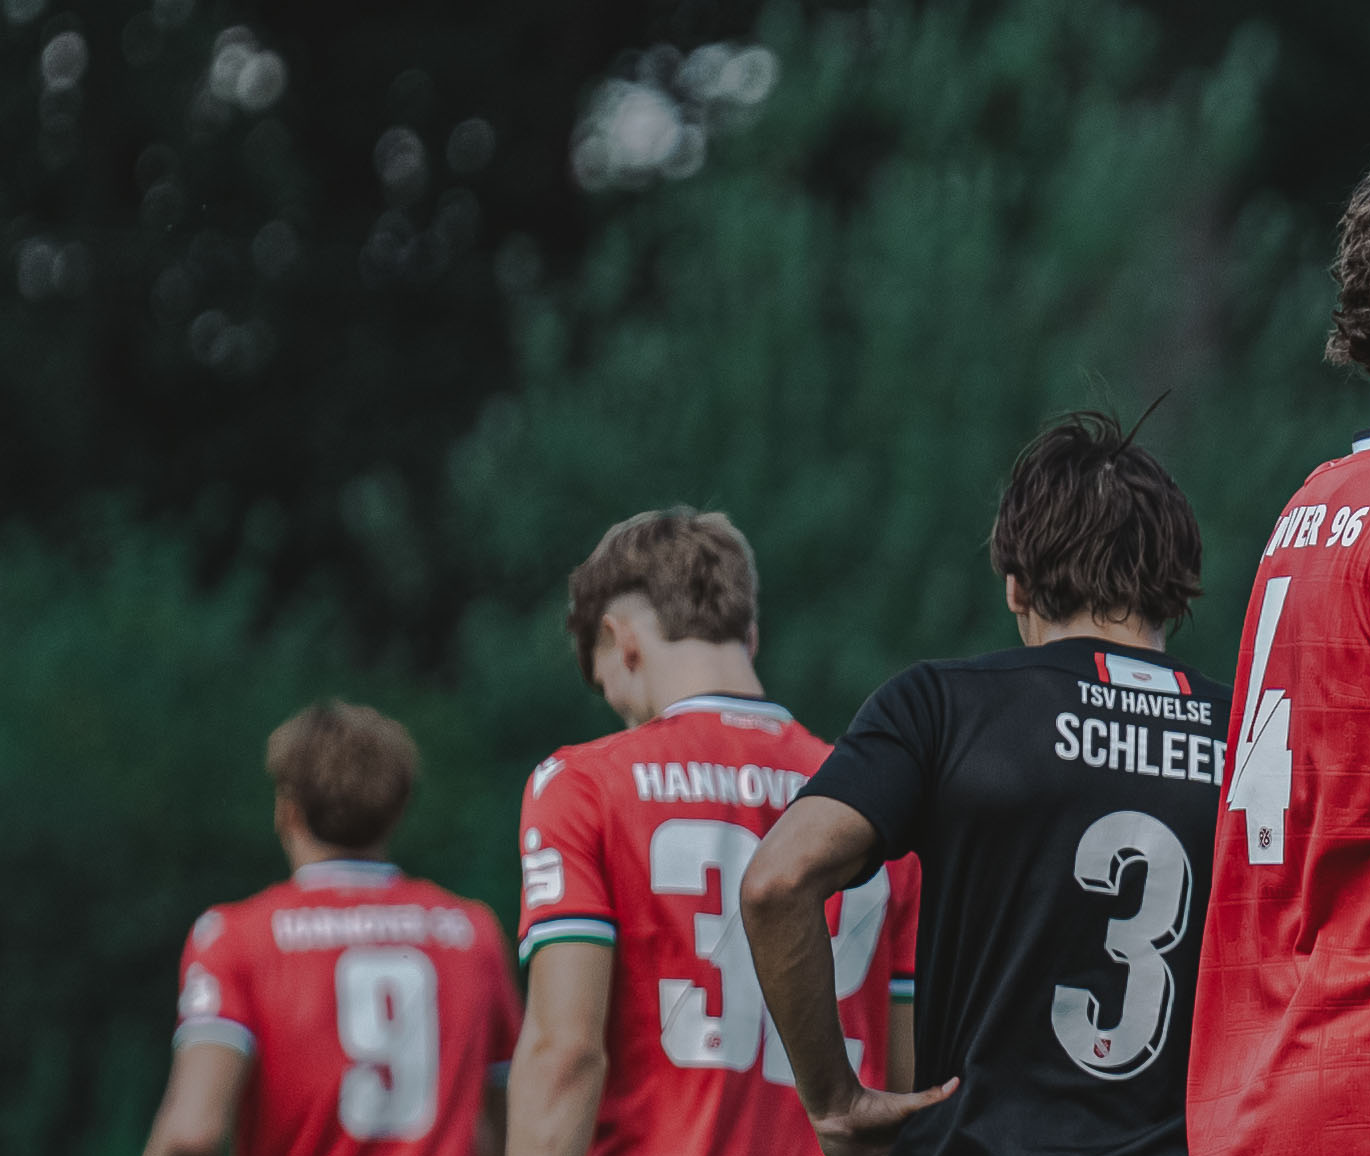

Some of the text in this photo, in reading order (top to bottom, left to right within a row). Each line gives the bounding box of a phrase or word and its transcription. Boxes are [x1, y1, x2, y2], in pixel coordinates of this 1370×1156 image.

[1325, 506, 1370, 548] 96
[1078, 681, 1212, 725] TSV HAVELSE
[1228, 577, 1292, 864] 4
[632, 761, 810, 809] HANNOV
[1051, 811, 1192, 1081] 3
[335, 945, 440, 1141] 9
